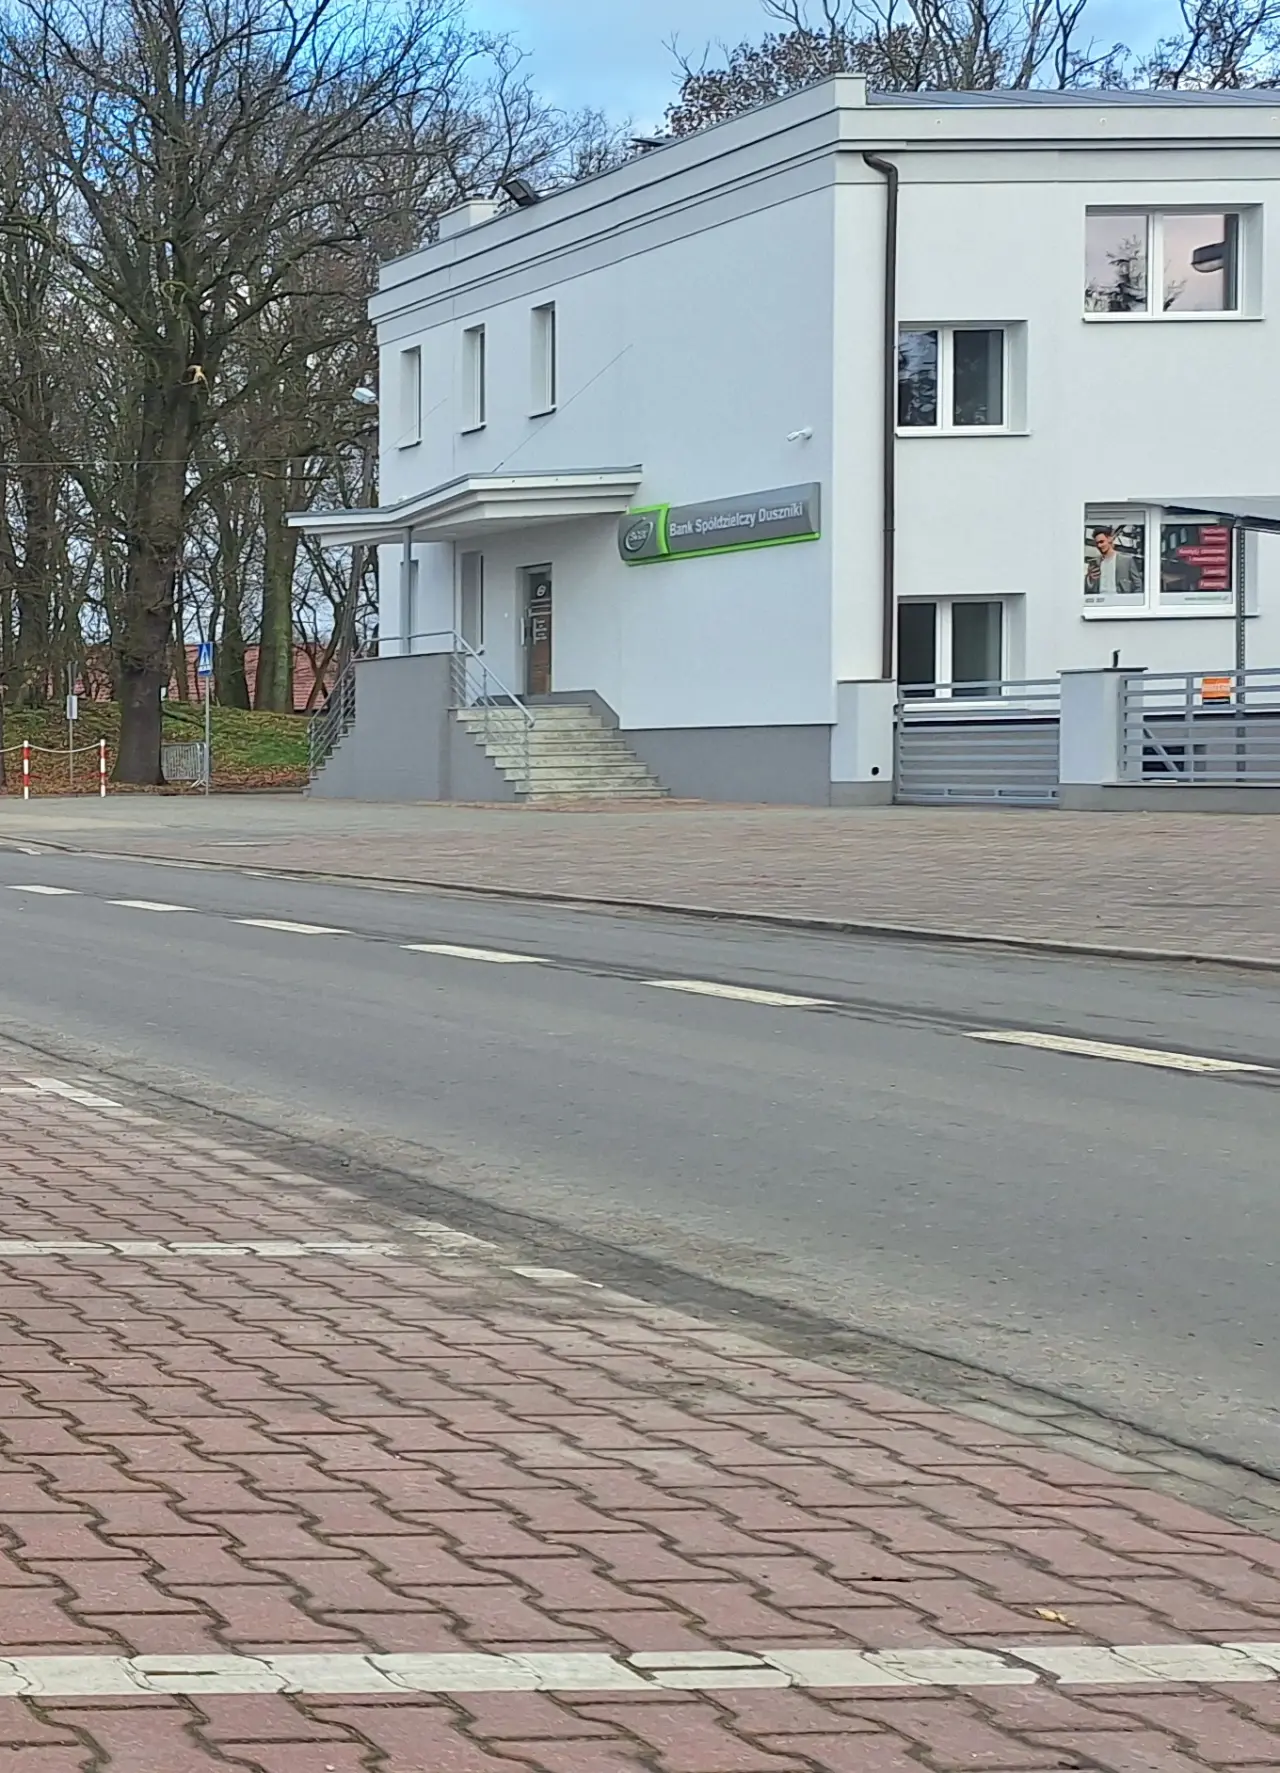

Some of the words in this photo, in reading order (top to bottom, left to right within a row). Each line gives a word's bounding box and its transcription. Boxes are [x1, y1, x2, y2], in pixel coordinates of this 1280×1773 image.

[670, 522, 693, 536] Bank
[695, 512, 756, 534] Spółdzielczy
[759, 502, 803, 522] Duszniki
